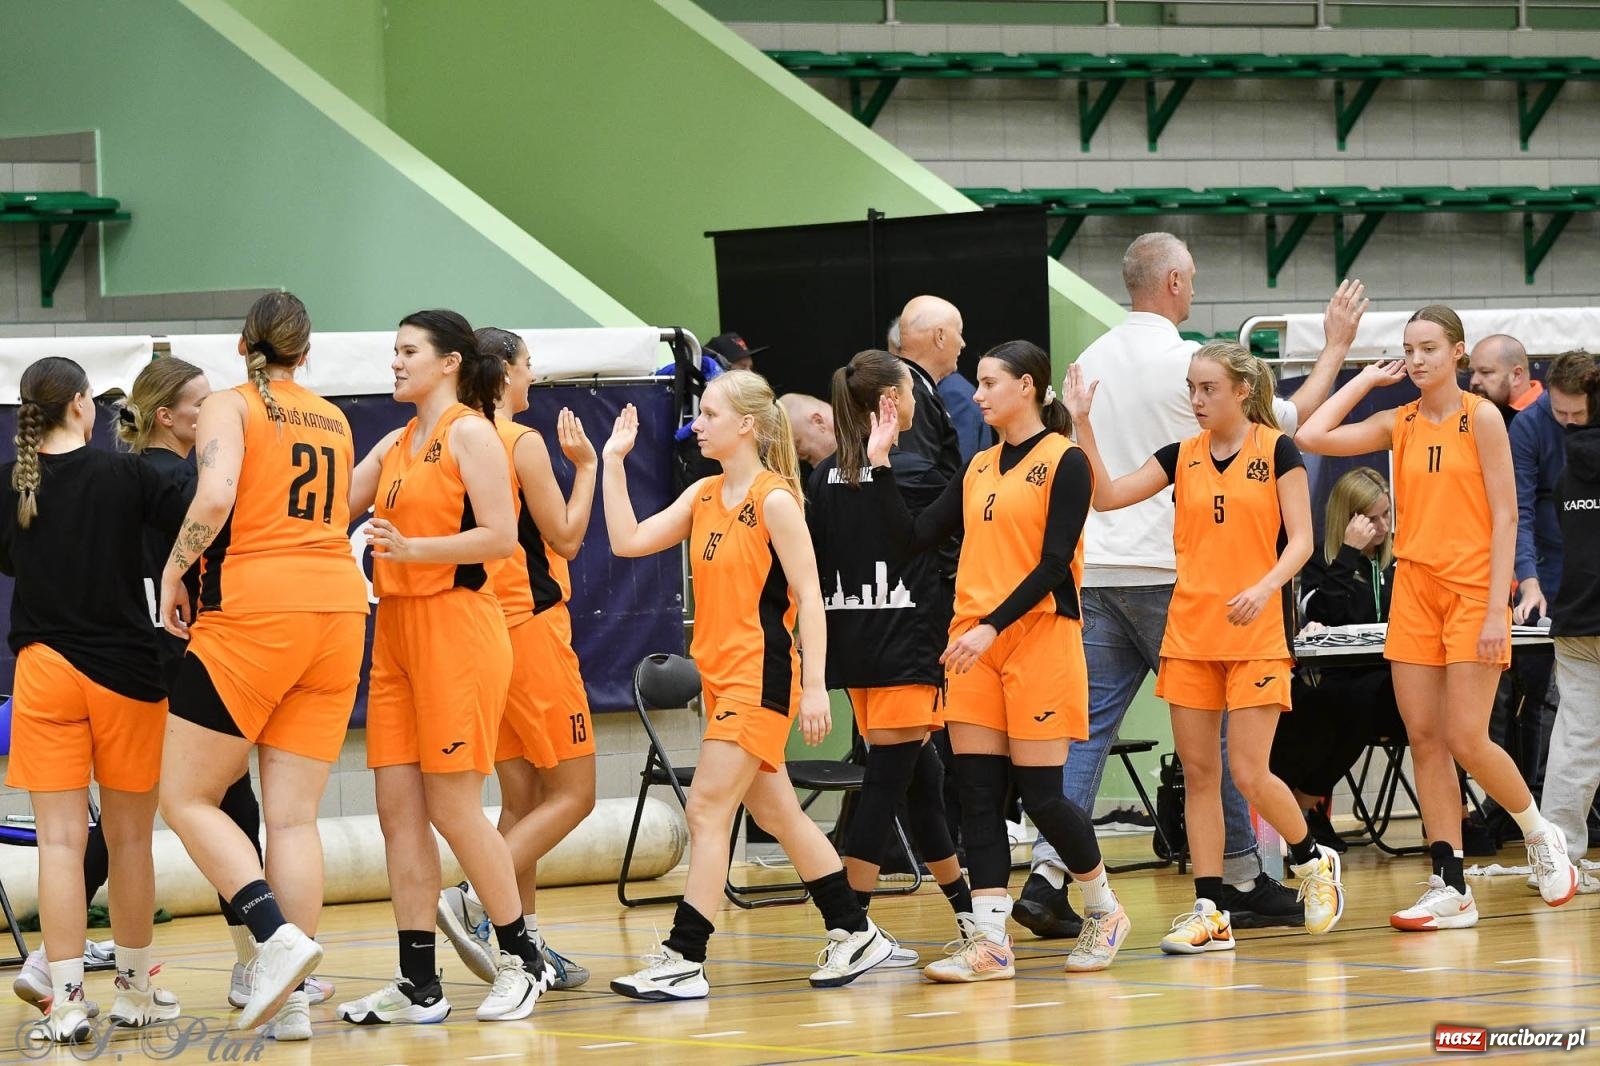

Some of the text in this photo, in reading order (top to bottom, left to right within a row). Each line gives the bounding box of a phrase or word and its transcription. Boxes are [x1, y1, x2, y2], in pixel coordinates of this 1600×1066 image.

[266, 406, 287, 423] AS
[1428, 446, 1442, 473] 11
[288, 442, 335, 524] 21
[983, 493, 996, 521] 2
[1214, 495, 1225, 524] 5
[569, 712, 587, 745] 13
